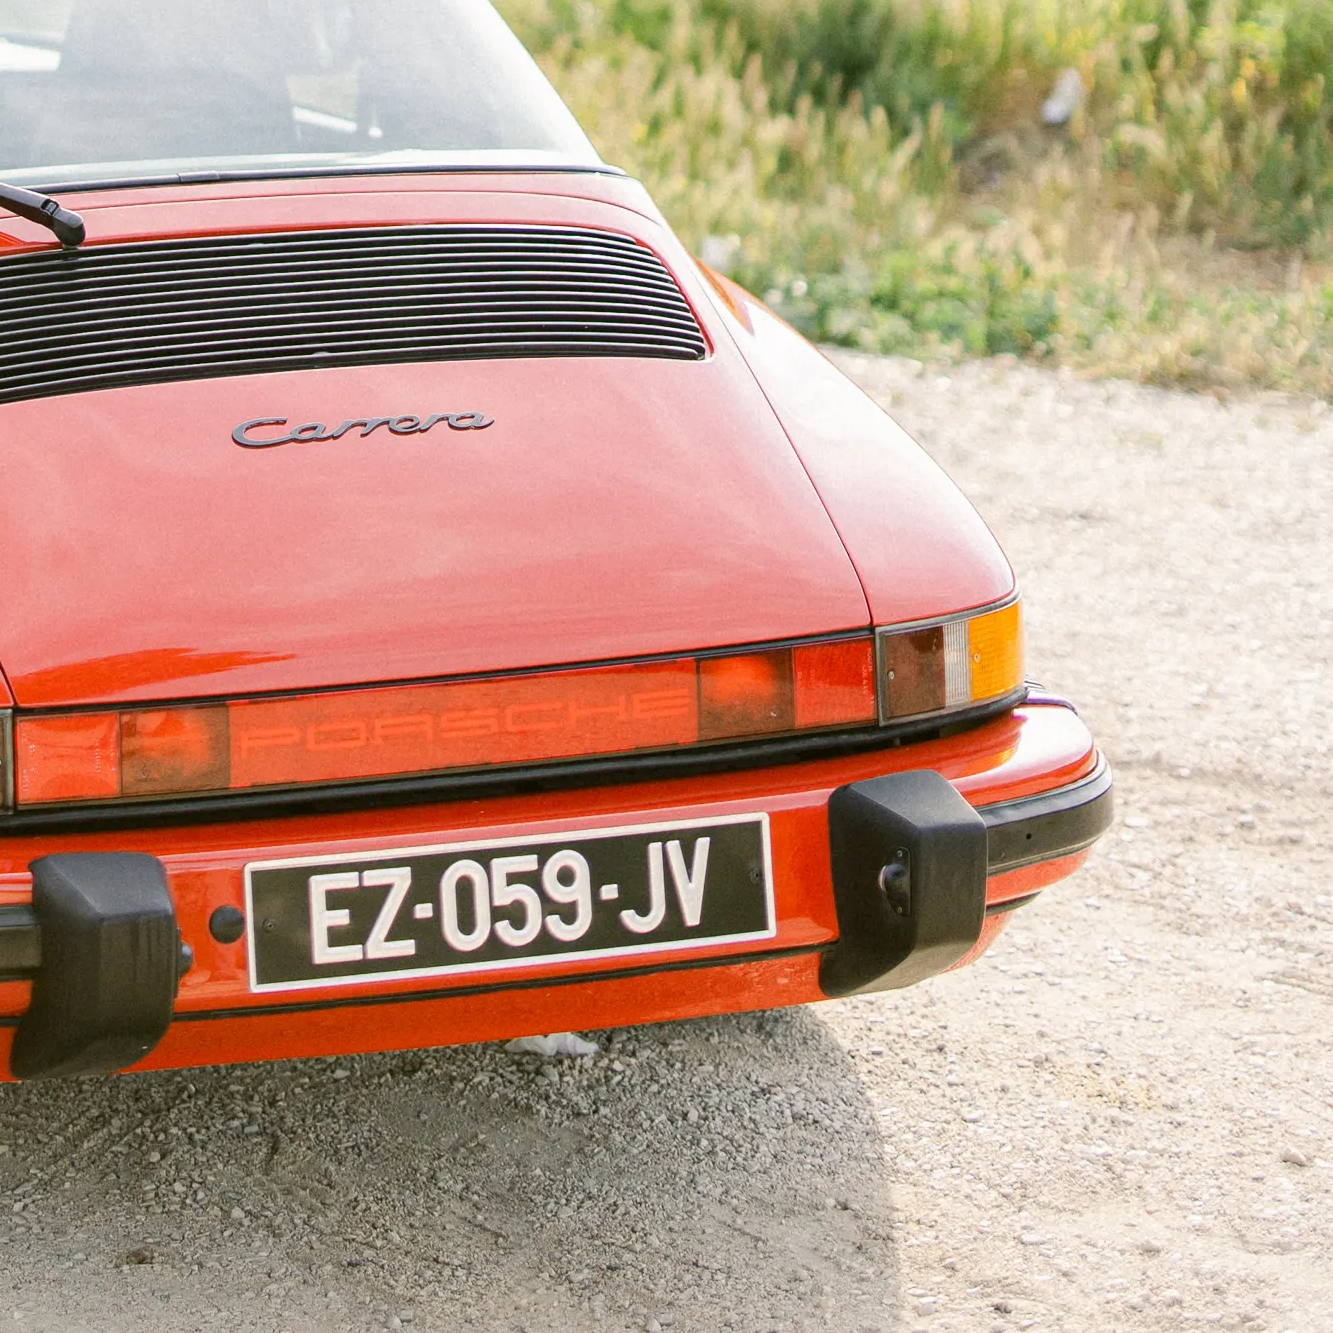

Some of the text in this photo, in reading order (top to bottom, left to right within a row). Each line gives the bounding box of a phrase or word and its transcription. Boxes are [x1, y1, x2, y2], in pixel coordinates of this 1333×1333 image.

[232, 410, 495, 448] Carrera
[240, 687, 689, 760] PORSCHE
[309, 836, 711, 966] EZ-059-JV
